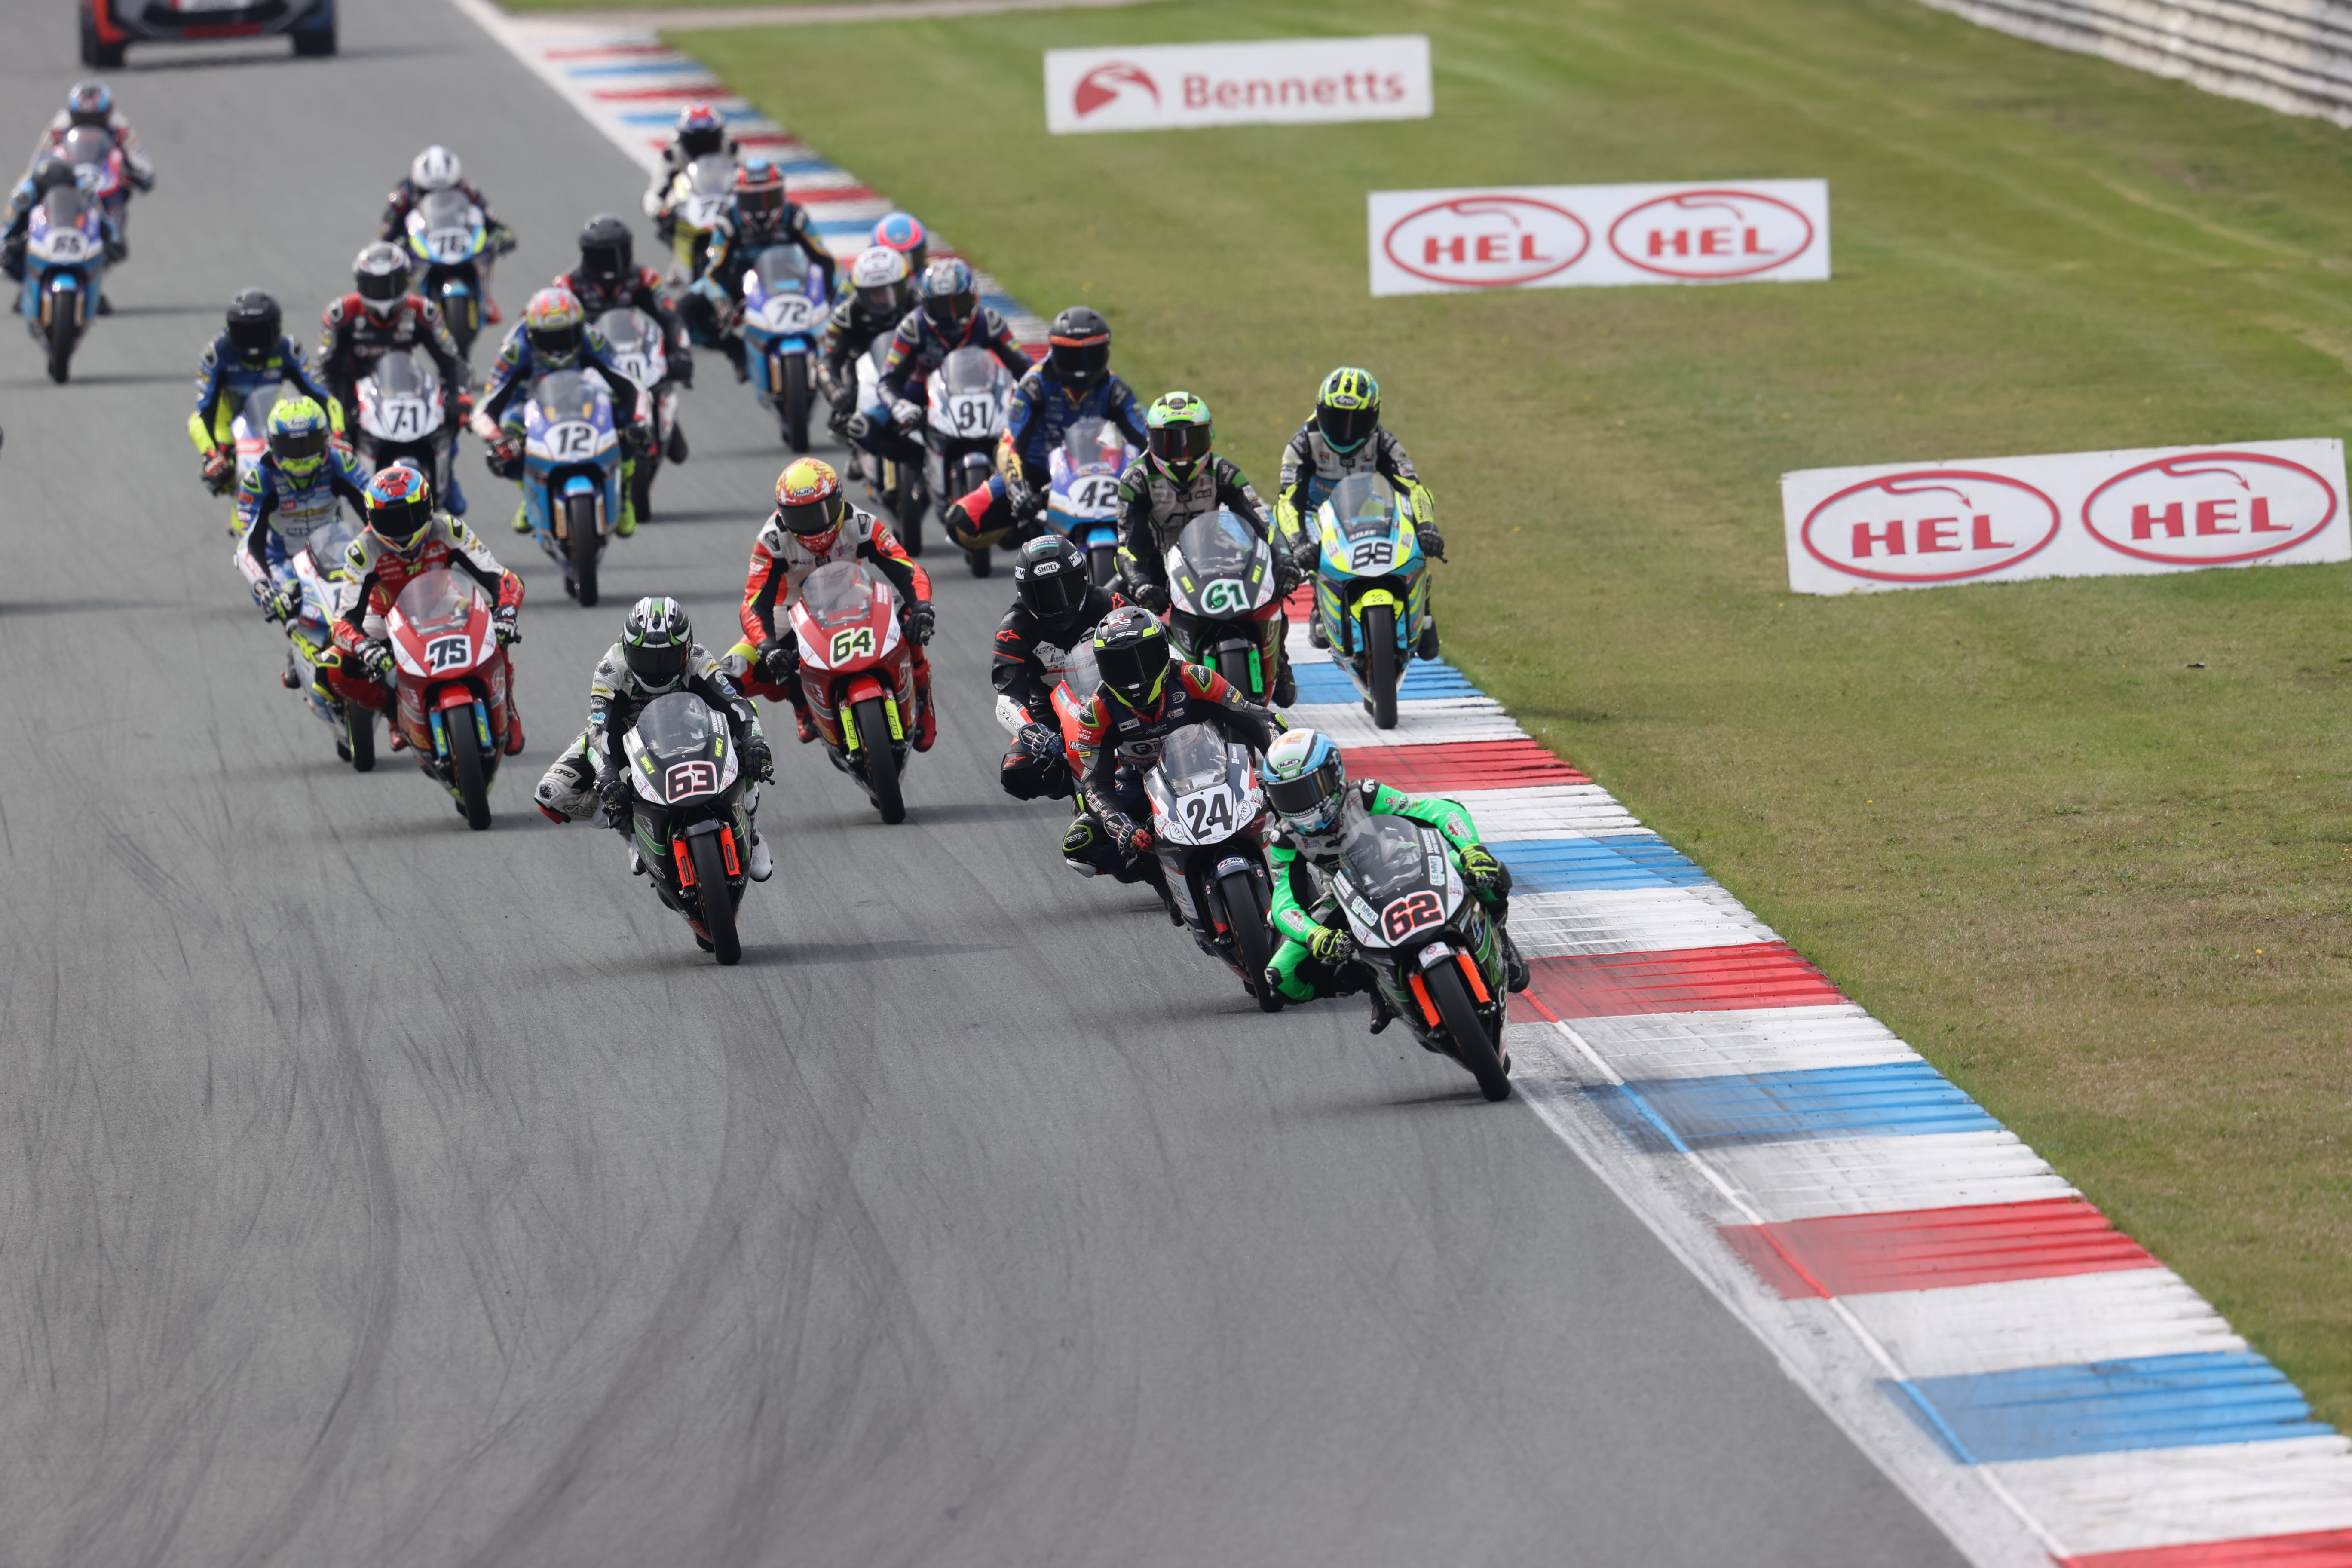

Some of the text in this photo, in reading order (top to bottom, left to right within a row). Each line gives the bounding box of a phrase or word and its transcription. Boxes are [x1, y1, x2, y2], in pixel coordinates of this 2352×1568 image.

[1183, 70, 1406, 109] Bennetts
[1424, 234, 1552, 264] HEL
[1648, 227, 1774, 257] HEL
[777, 302, 808, 325] 72
[1335, 395, 1357, 405] Arai
[391, 406, 418, 433] 71
[959, 401, 986, 430] 91
[559, 426, 592, 454] 12
[1079, 480, 1118, 508] 42
[2132, 496, 2292, 540] HEL
[1852, 514, 2015, 557] HEL
[1037, 564, 1057, 573] SHOEI
[1205, 582, 1245, 611] 61
[645, 632, 668, 641] Arai
[833, 630, 872, 663] 64
[1036, 646, 1055, 654] R&G
[1106, 631, 1139, 643] LS2
[429, 638, 467, 669] 75
[997, 704, 1021, 732] alpinesta
[1081, 708, 1093, 718] ST
[640, 755, 653, 770] RYDE
[715, 741, 723, 758] RYDE
[1280, 758, 1297, 768] HJC
[668, 764, 715, 801] 63
[1187, 793, 1232, 840] 24
[1065, 831, 1087, 845] RST
[1430, 857, 1439, 886] SEMMS
[1354, 897, 1377, 922] SEMMS
[1384, 893, 1443, 942] 62
[1354, 924, 1366, 937] British
